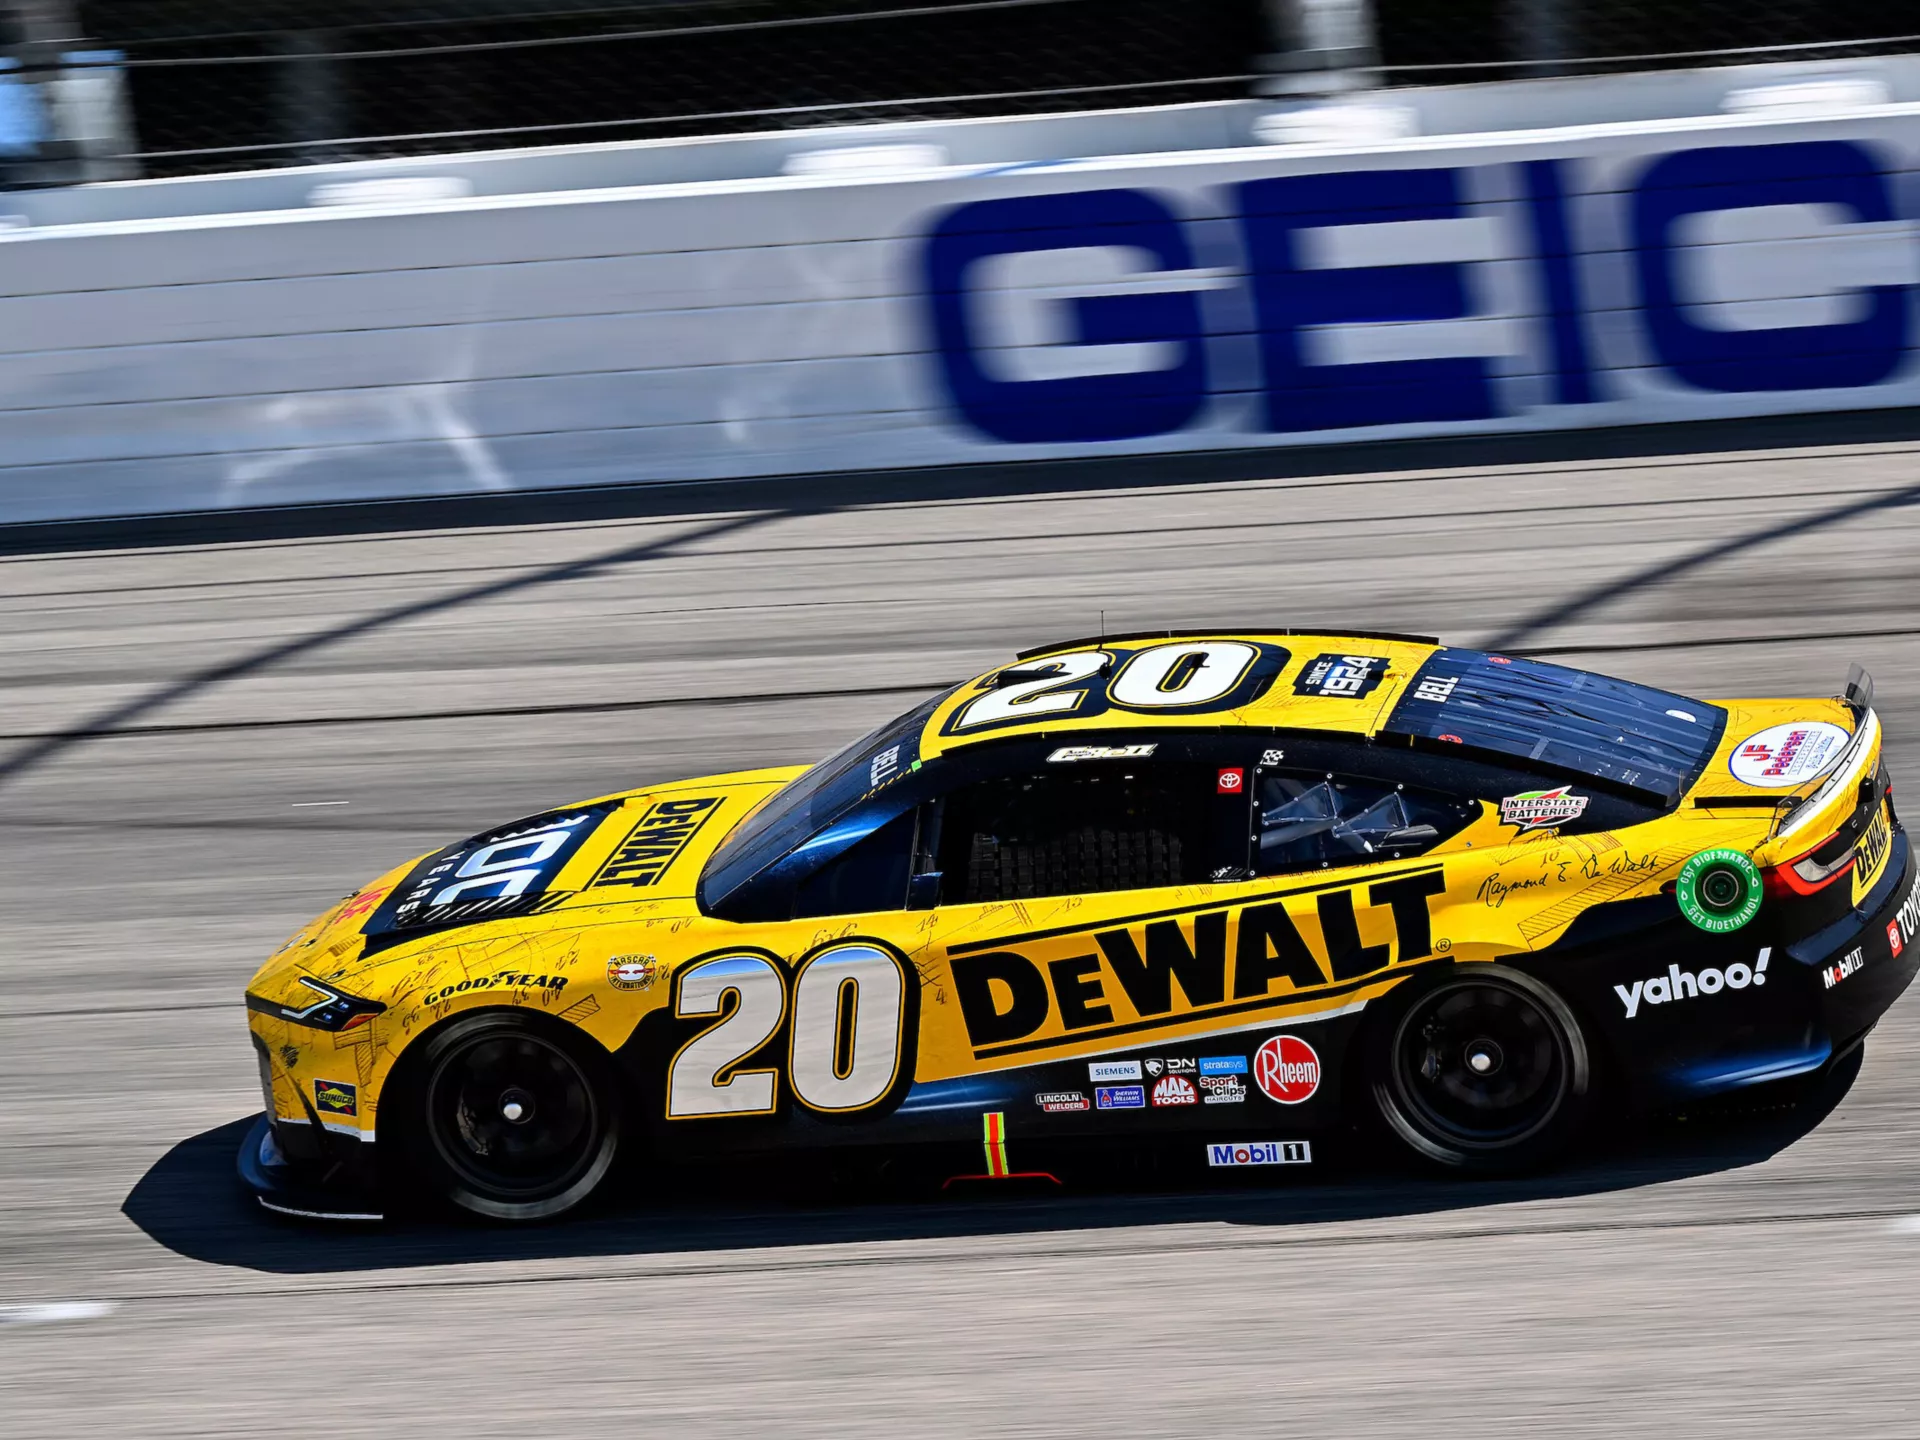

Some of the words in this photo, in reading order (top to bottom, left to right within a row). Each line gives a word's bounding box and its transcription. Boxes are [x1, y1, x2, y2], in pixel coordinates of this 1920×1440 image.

[1304, 660, 1333, 686] SINCE
[1318, 655, 1379, 696] 1924
[950, 639, 1262, 732] 20
[1413, 675, 1460, 703] BELL
[870, 744, 900, 787] BELL
[1505, 798, 1583, 809] INTERSTATE
[1507, 807, 1579, 819] BATTERIES
[591, 796, 719, 889] DEWALT
[396, 850, 466, 914] YEARS
[1687, 906, 1706, 924] GET
[1705, 895, 1760, 930] BIOETHANOL
[613, 955, 651, 968] NASCAR
[1822, 954, 1854, 990] Mobil
[423, 969, 569, 1006] GOODYEAR
[1613, 946, 1772, 1019] yahoo!
[665, 942, 907, 1120] 20
[1095, 1066, 1136, 1076] SIEMENS
[1167, 1057, 1196, 1069] DN
[1203, 1061, 1244, 1070] stratasys
[1261, 1037, 1317, 1093] Rheem
[1154, 1076, 1194, 1098] MAC
[1201, 1075, 1238, 1087] Sport
[1213, 1085, 1245, 1097] Clips
[318, 1092, 353, 1105] SUNOCO
[1038, 1093, 1080, 1104] LINCOLN
[1048, 1101, 1085, 1111] WELDERS
[1154, 1095, 1197, 1105] TOOLS
[1206, 1095, 1243, 1103] HAIRCUTS
[1213, 1143, 1278, 1164] Mobil
[1288, 1144, 1299, 1161] 1
